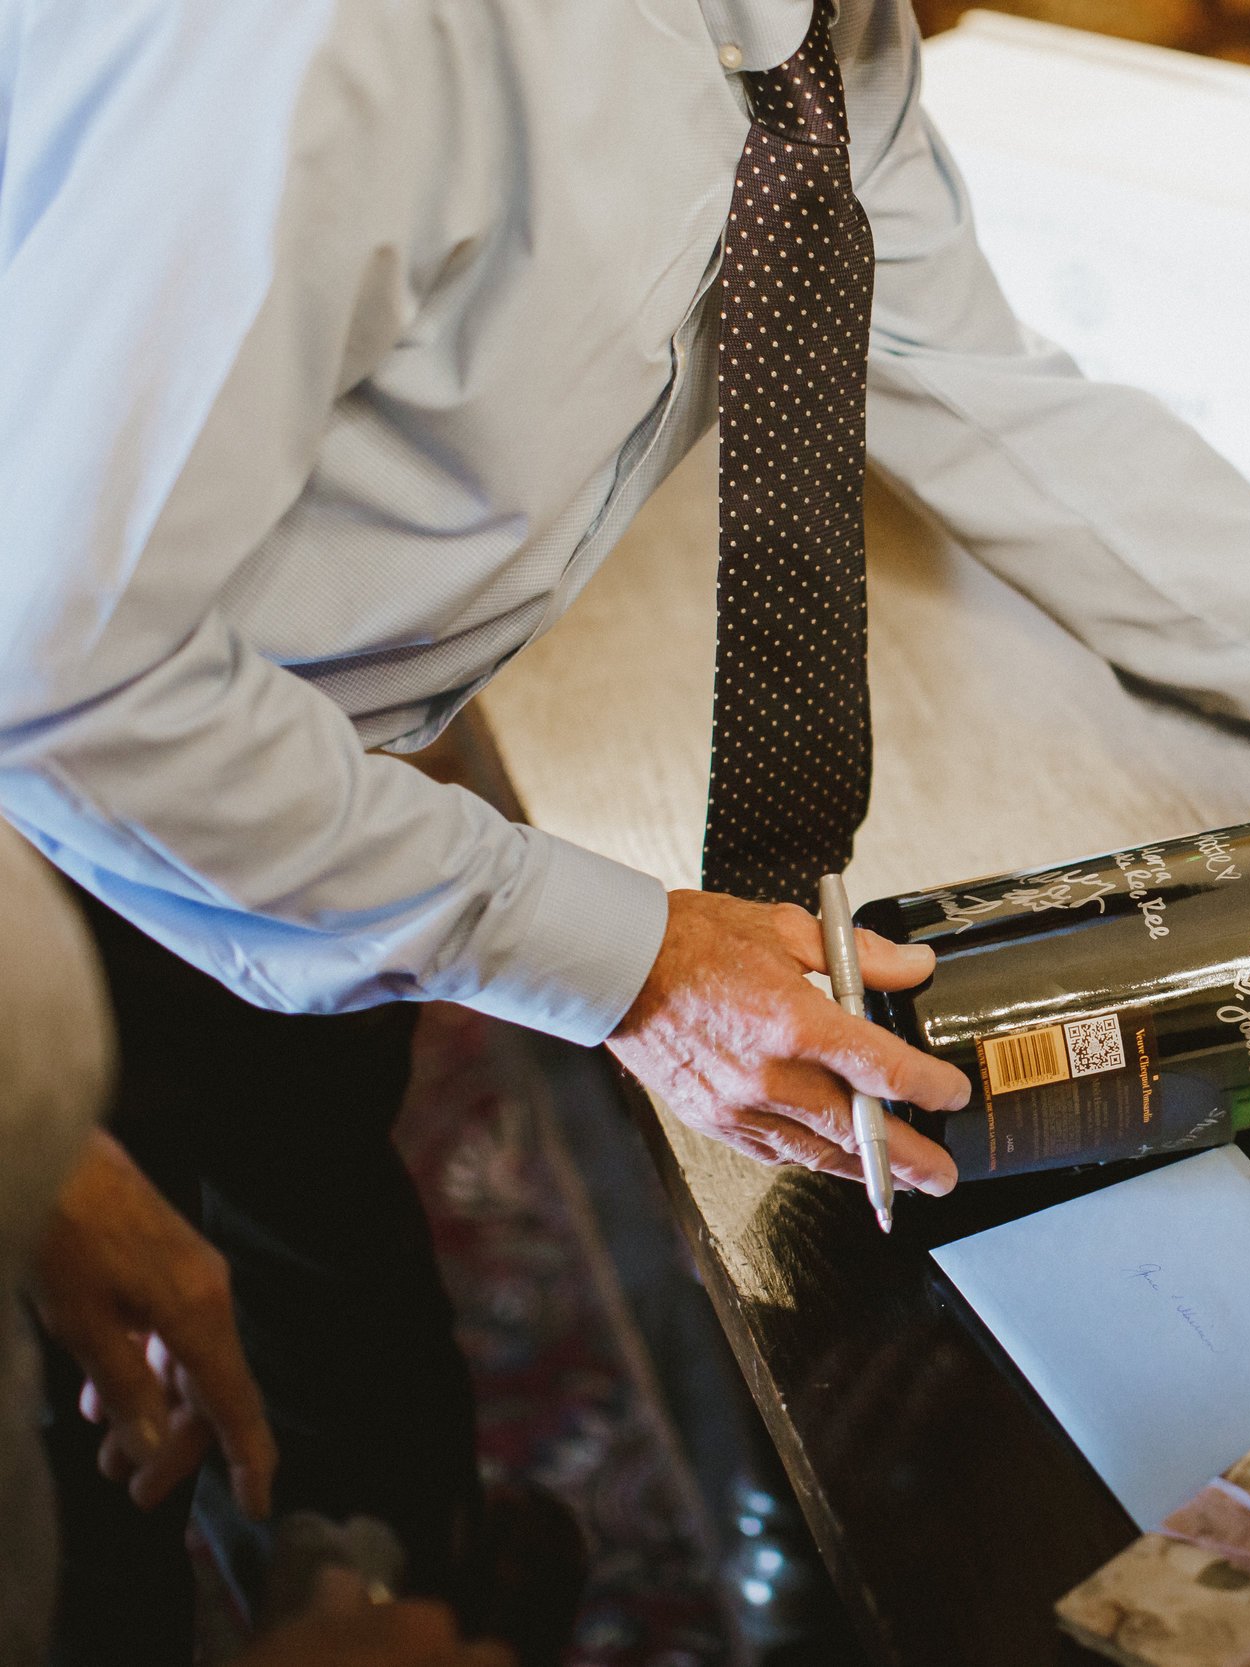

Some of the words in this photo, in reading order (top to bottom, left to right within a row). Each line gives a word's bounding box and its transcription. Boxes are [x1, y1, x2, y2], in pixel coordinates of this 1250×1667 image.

[1137, 896, 1170, 940] Ree
[1136, 1028, 1145, 1055] Veuve
[1140, 1055, 1150, 1089] Clicquot
[1143, 1089, 1153, 1124] Ponsardin
